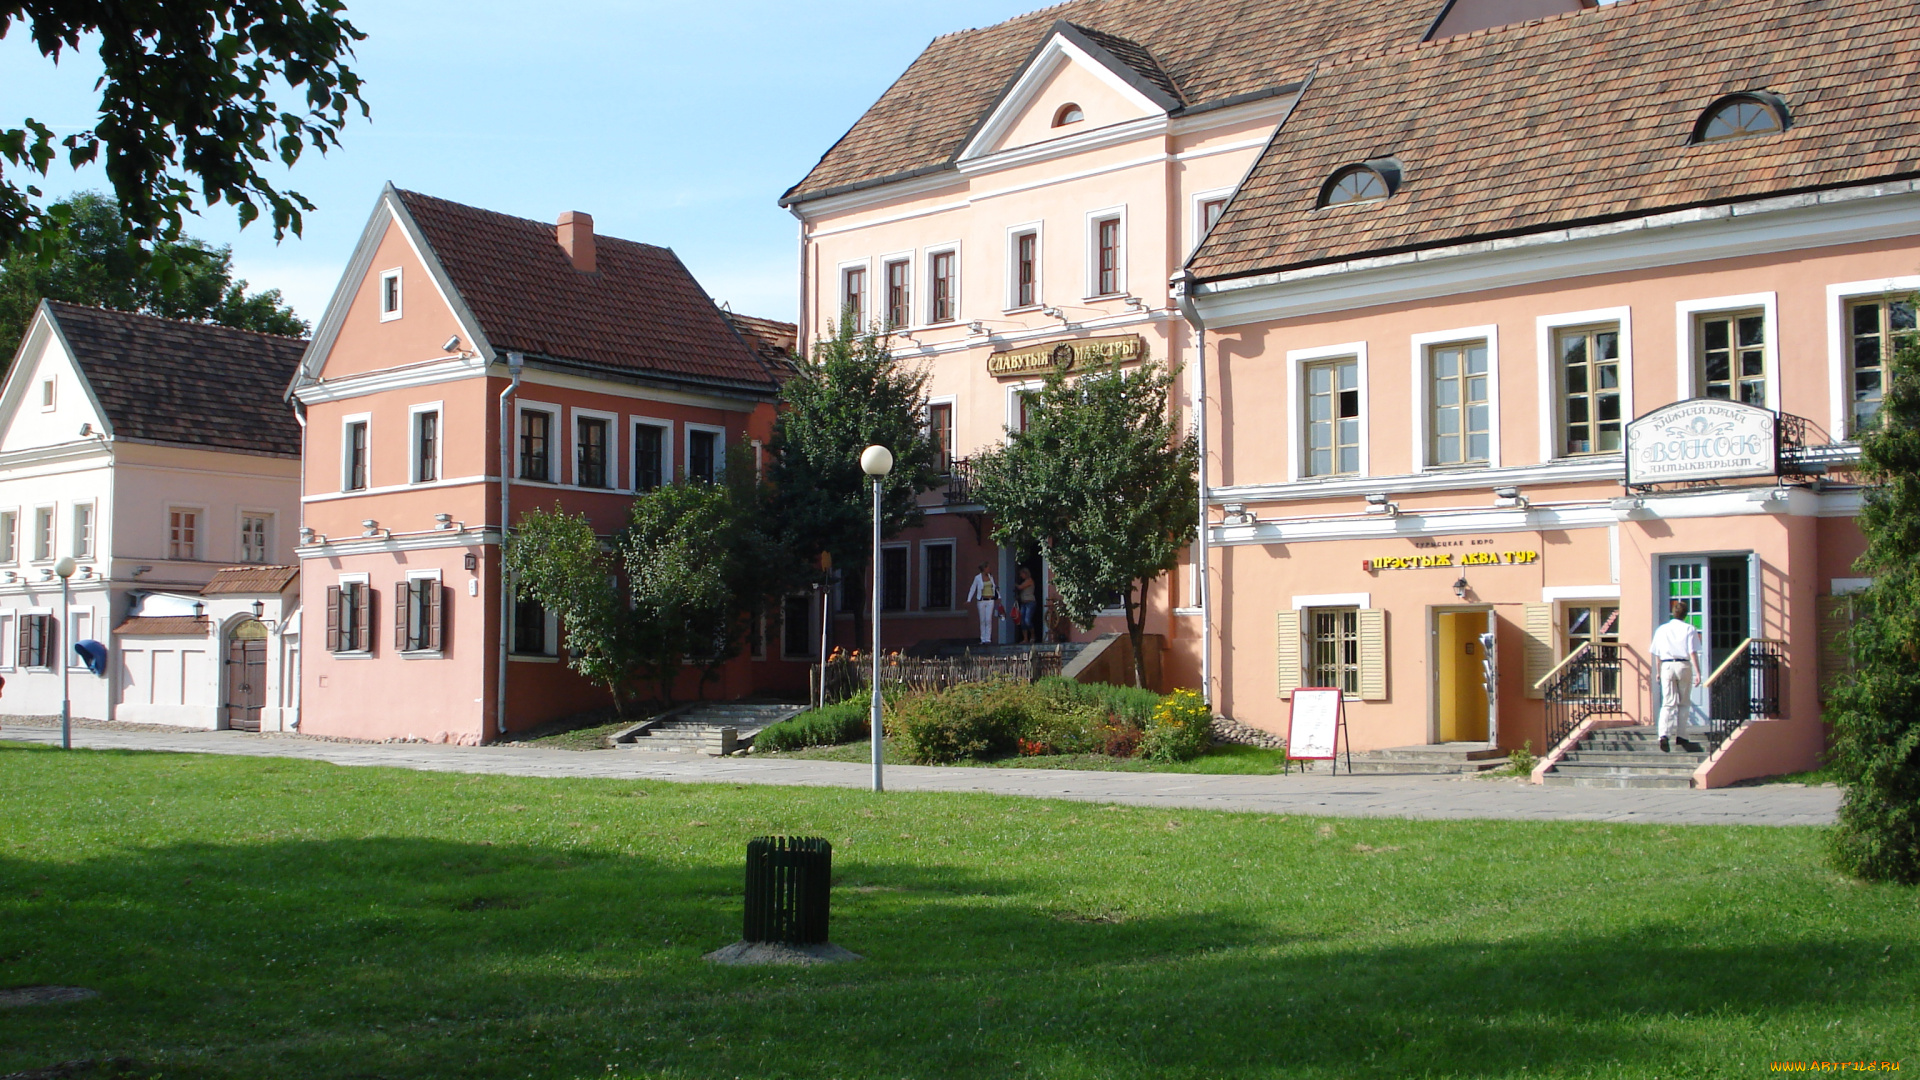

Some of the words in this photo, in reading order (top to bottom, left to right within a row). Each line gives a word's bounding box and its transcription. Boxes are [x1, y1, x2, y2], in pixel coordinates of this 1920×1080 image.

[988, 351, 1049, 371] СЛАВУТЫЯ
[1653, 406, 1706, 431] КНІЖНАЯ
[1709, 406, 1747, 424] КРАМА
[1641, 434, 1761, 463] ВЯНОК
[1650, 458, 1751, 473] АНТЫКВАРЫЯТ
[1471, 538, 1494, 546] БЮРО
[1373, 553, 1452, 569] ПРЭСТЫЖ
[1461, 551, 1499, 565] АКВА
[1504, 550, 1537, 563] ТУР
